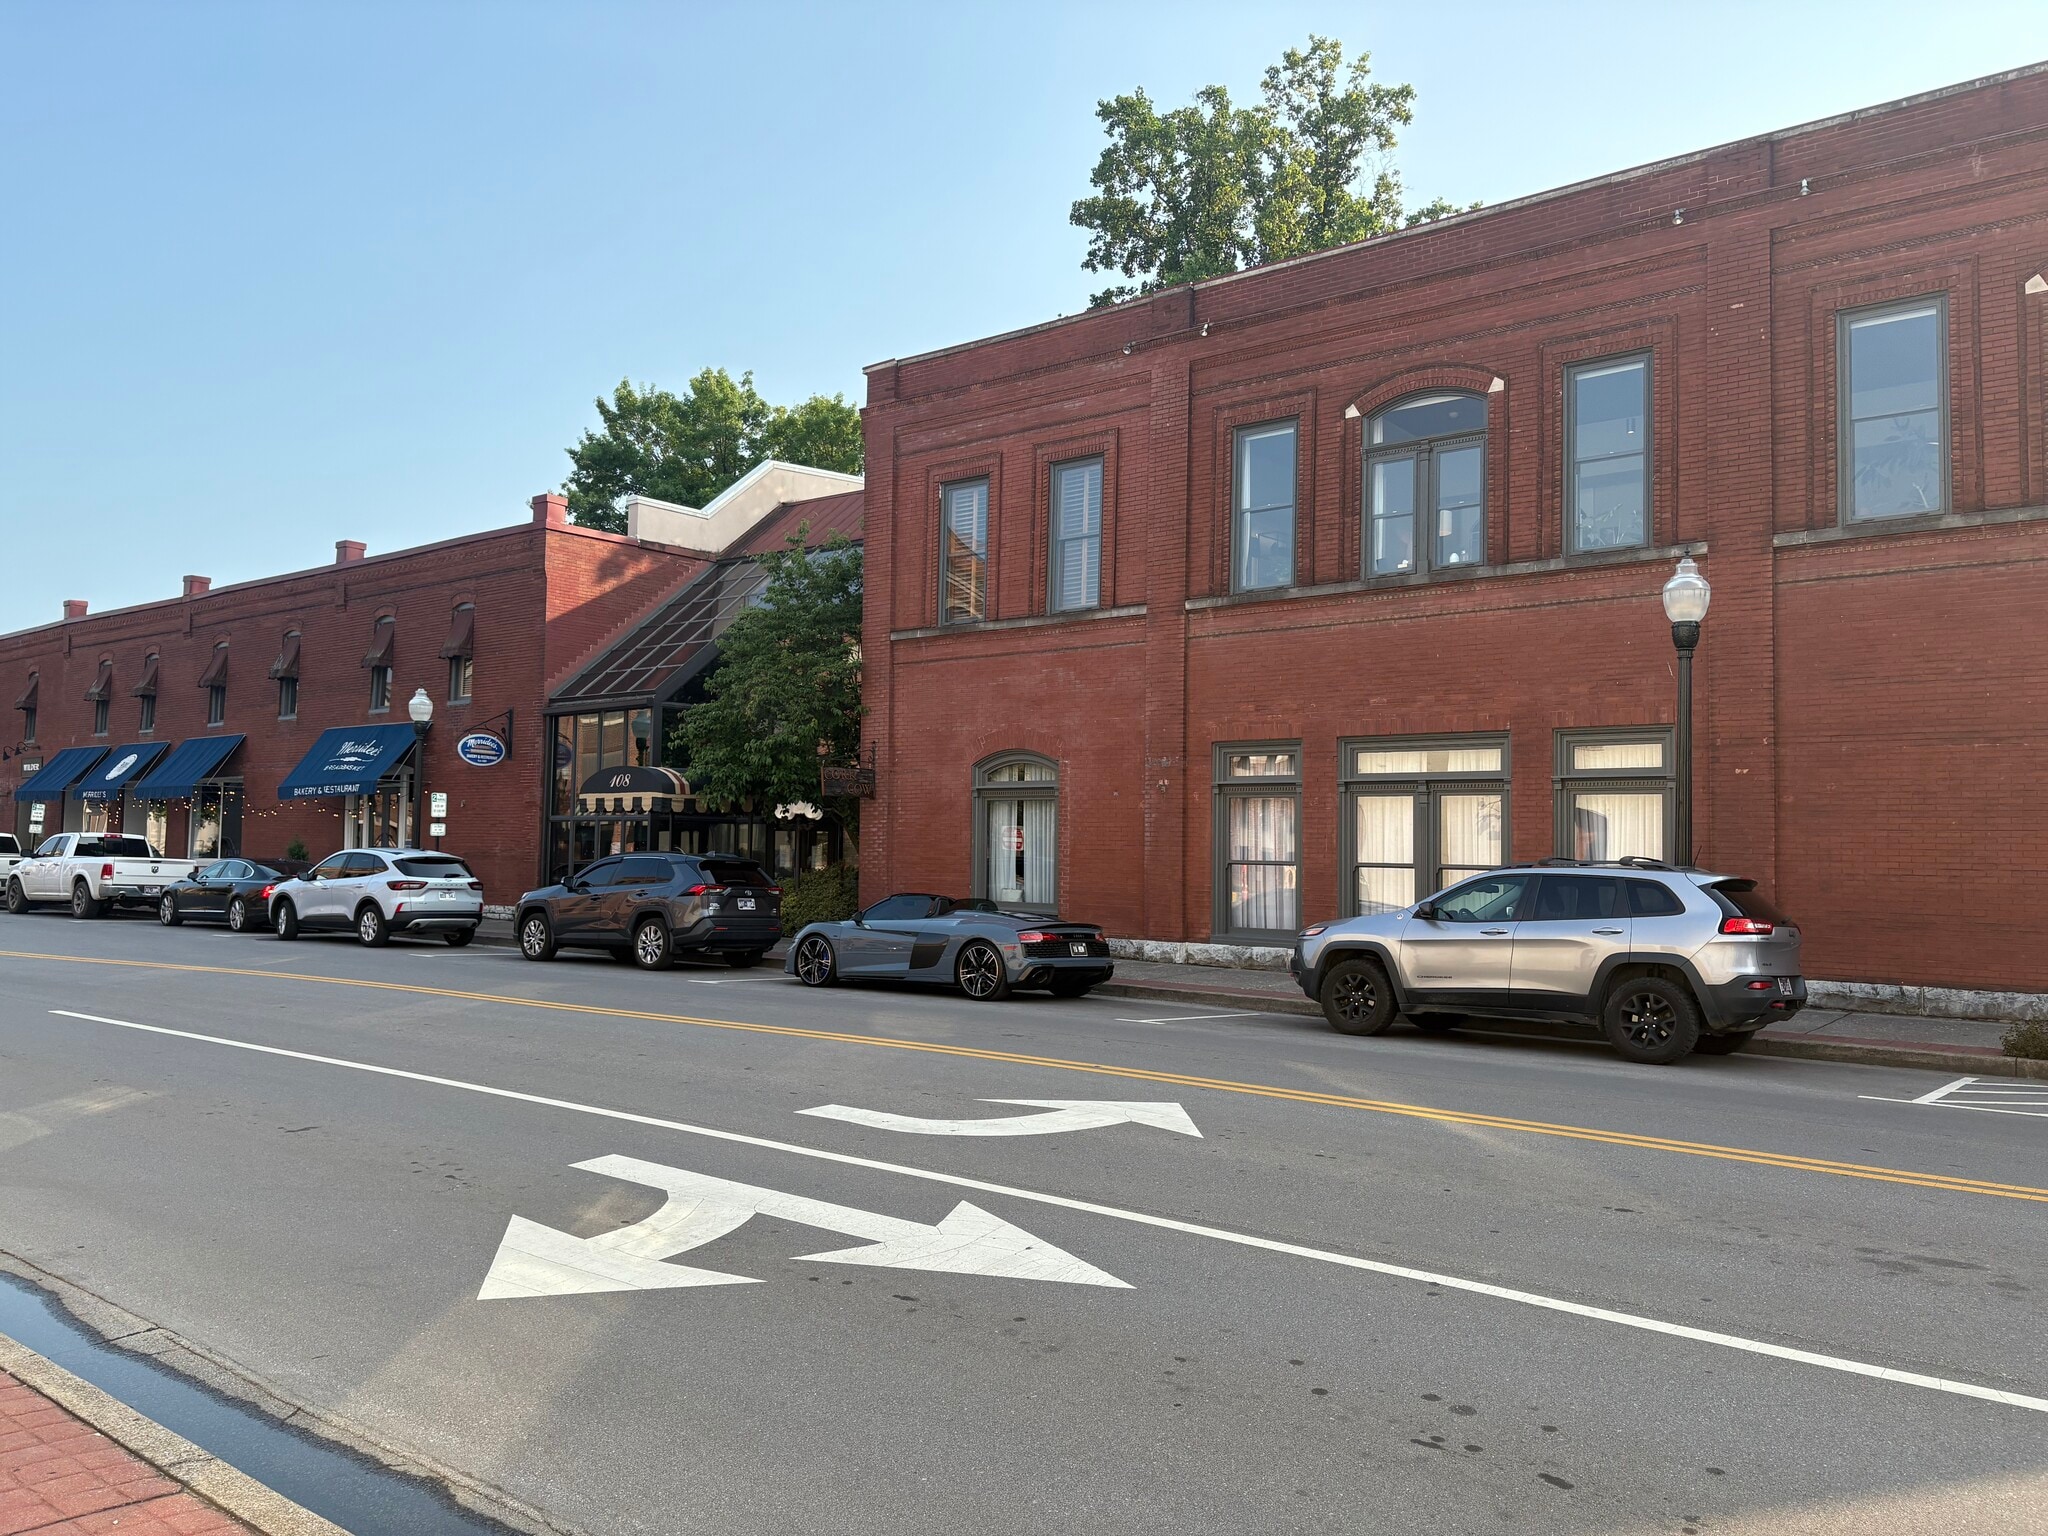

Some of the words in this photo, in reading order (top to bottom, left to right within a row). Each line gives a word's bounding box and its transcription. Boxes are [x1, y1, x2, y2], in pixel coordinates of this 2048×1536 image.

[609, 773, 631, 788] 108
[294, 787, 317, 796] BAKERY
[318, 786, 323, 794] &
